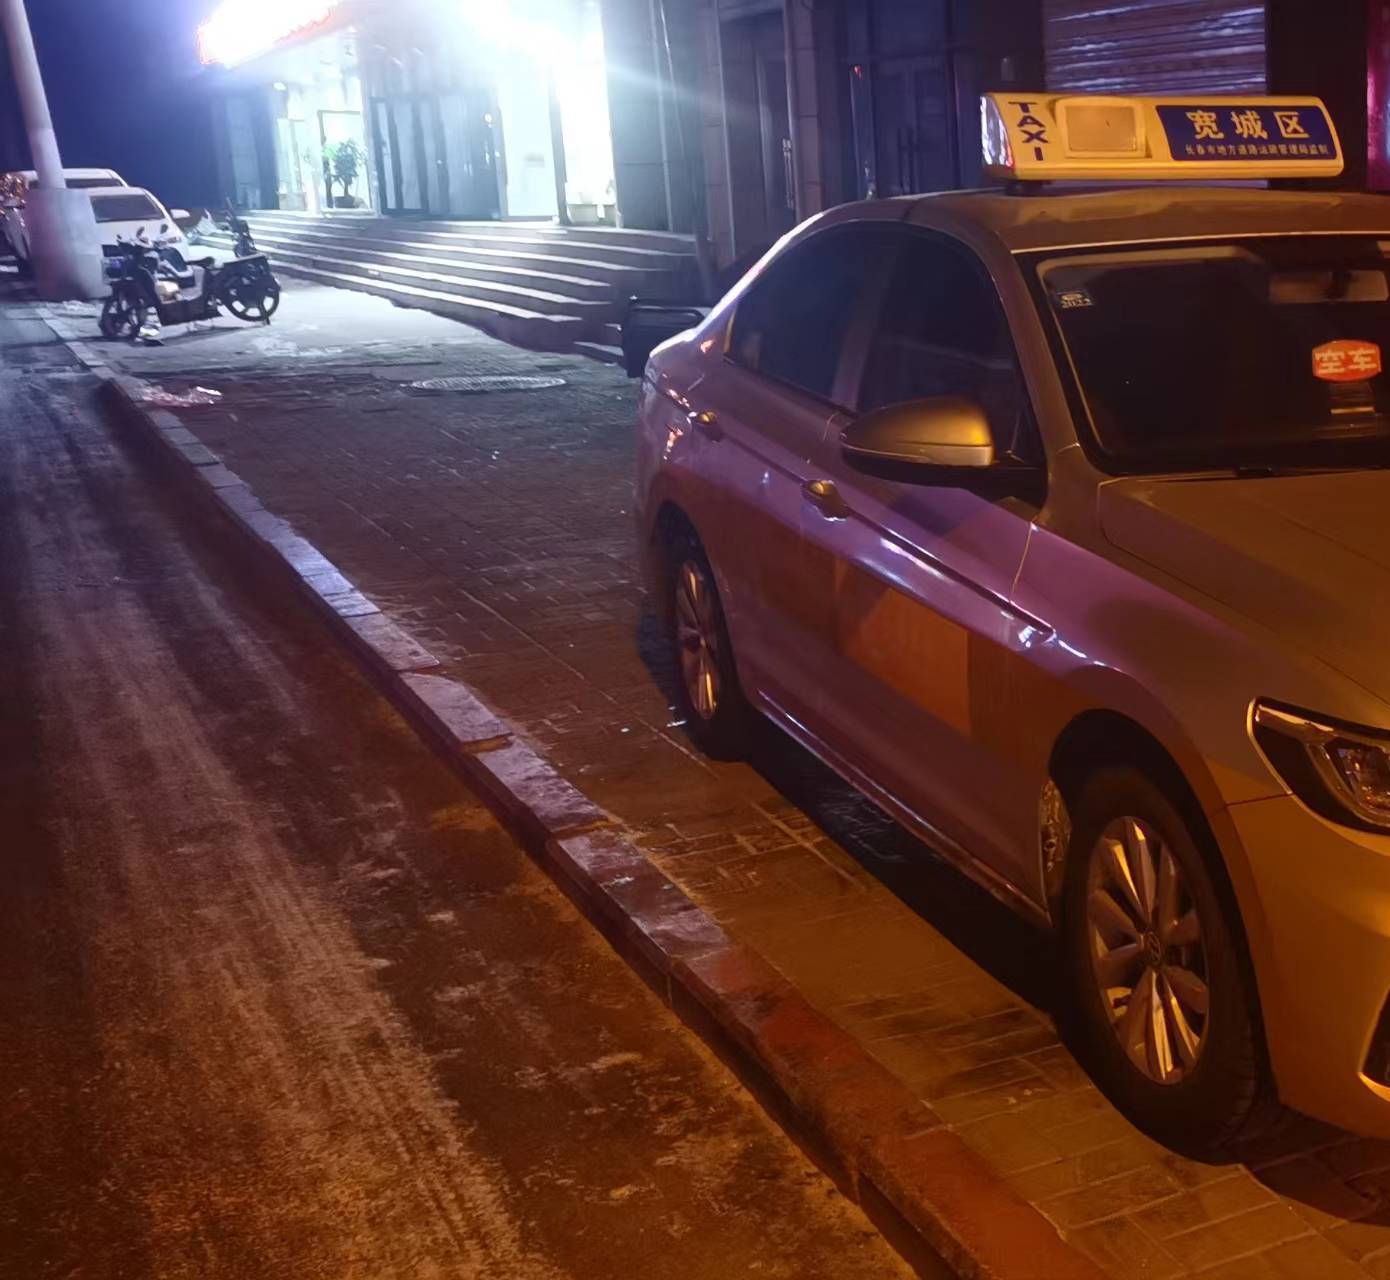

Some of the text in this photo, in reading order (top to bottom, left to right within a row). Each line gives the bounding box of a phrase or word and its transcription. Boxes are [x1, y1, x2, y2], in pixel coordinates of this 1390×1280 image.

[1008, 101, 1049, 161] TAXI
[1185, 110, 1310, 140] 宽城区
[1315, 348, 1377, 373] 空车
